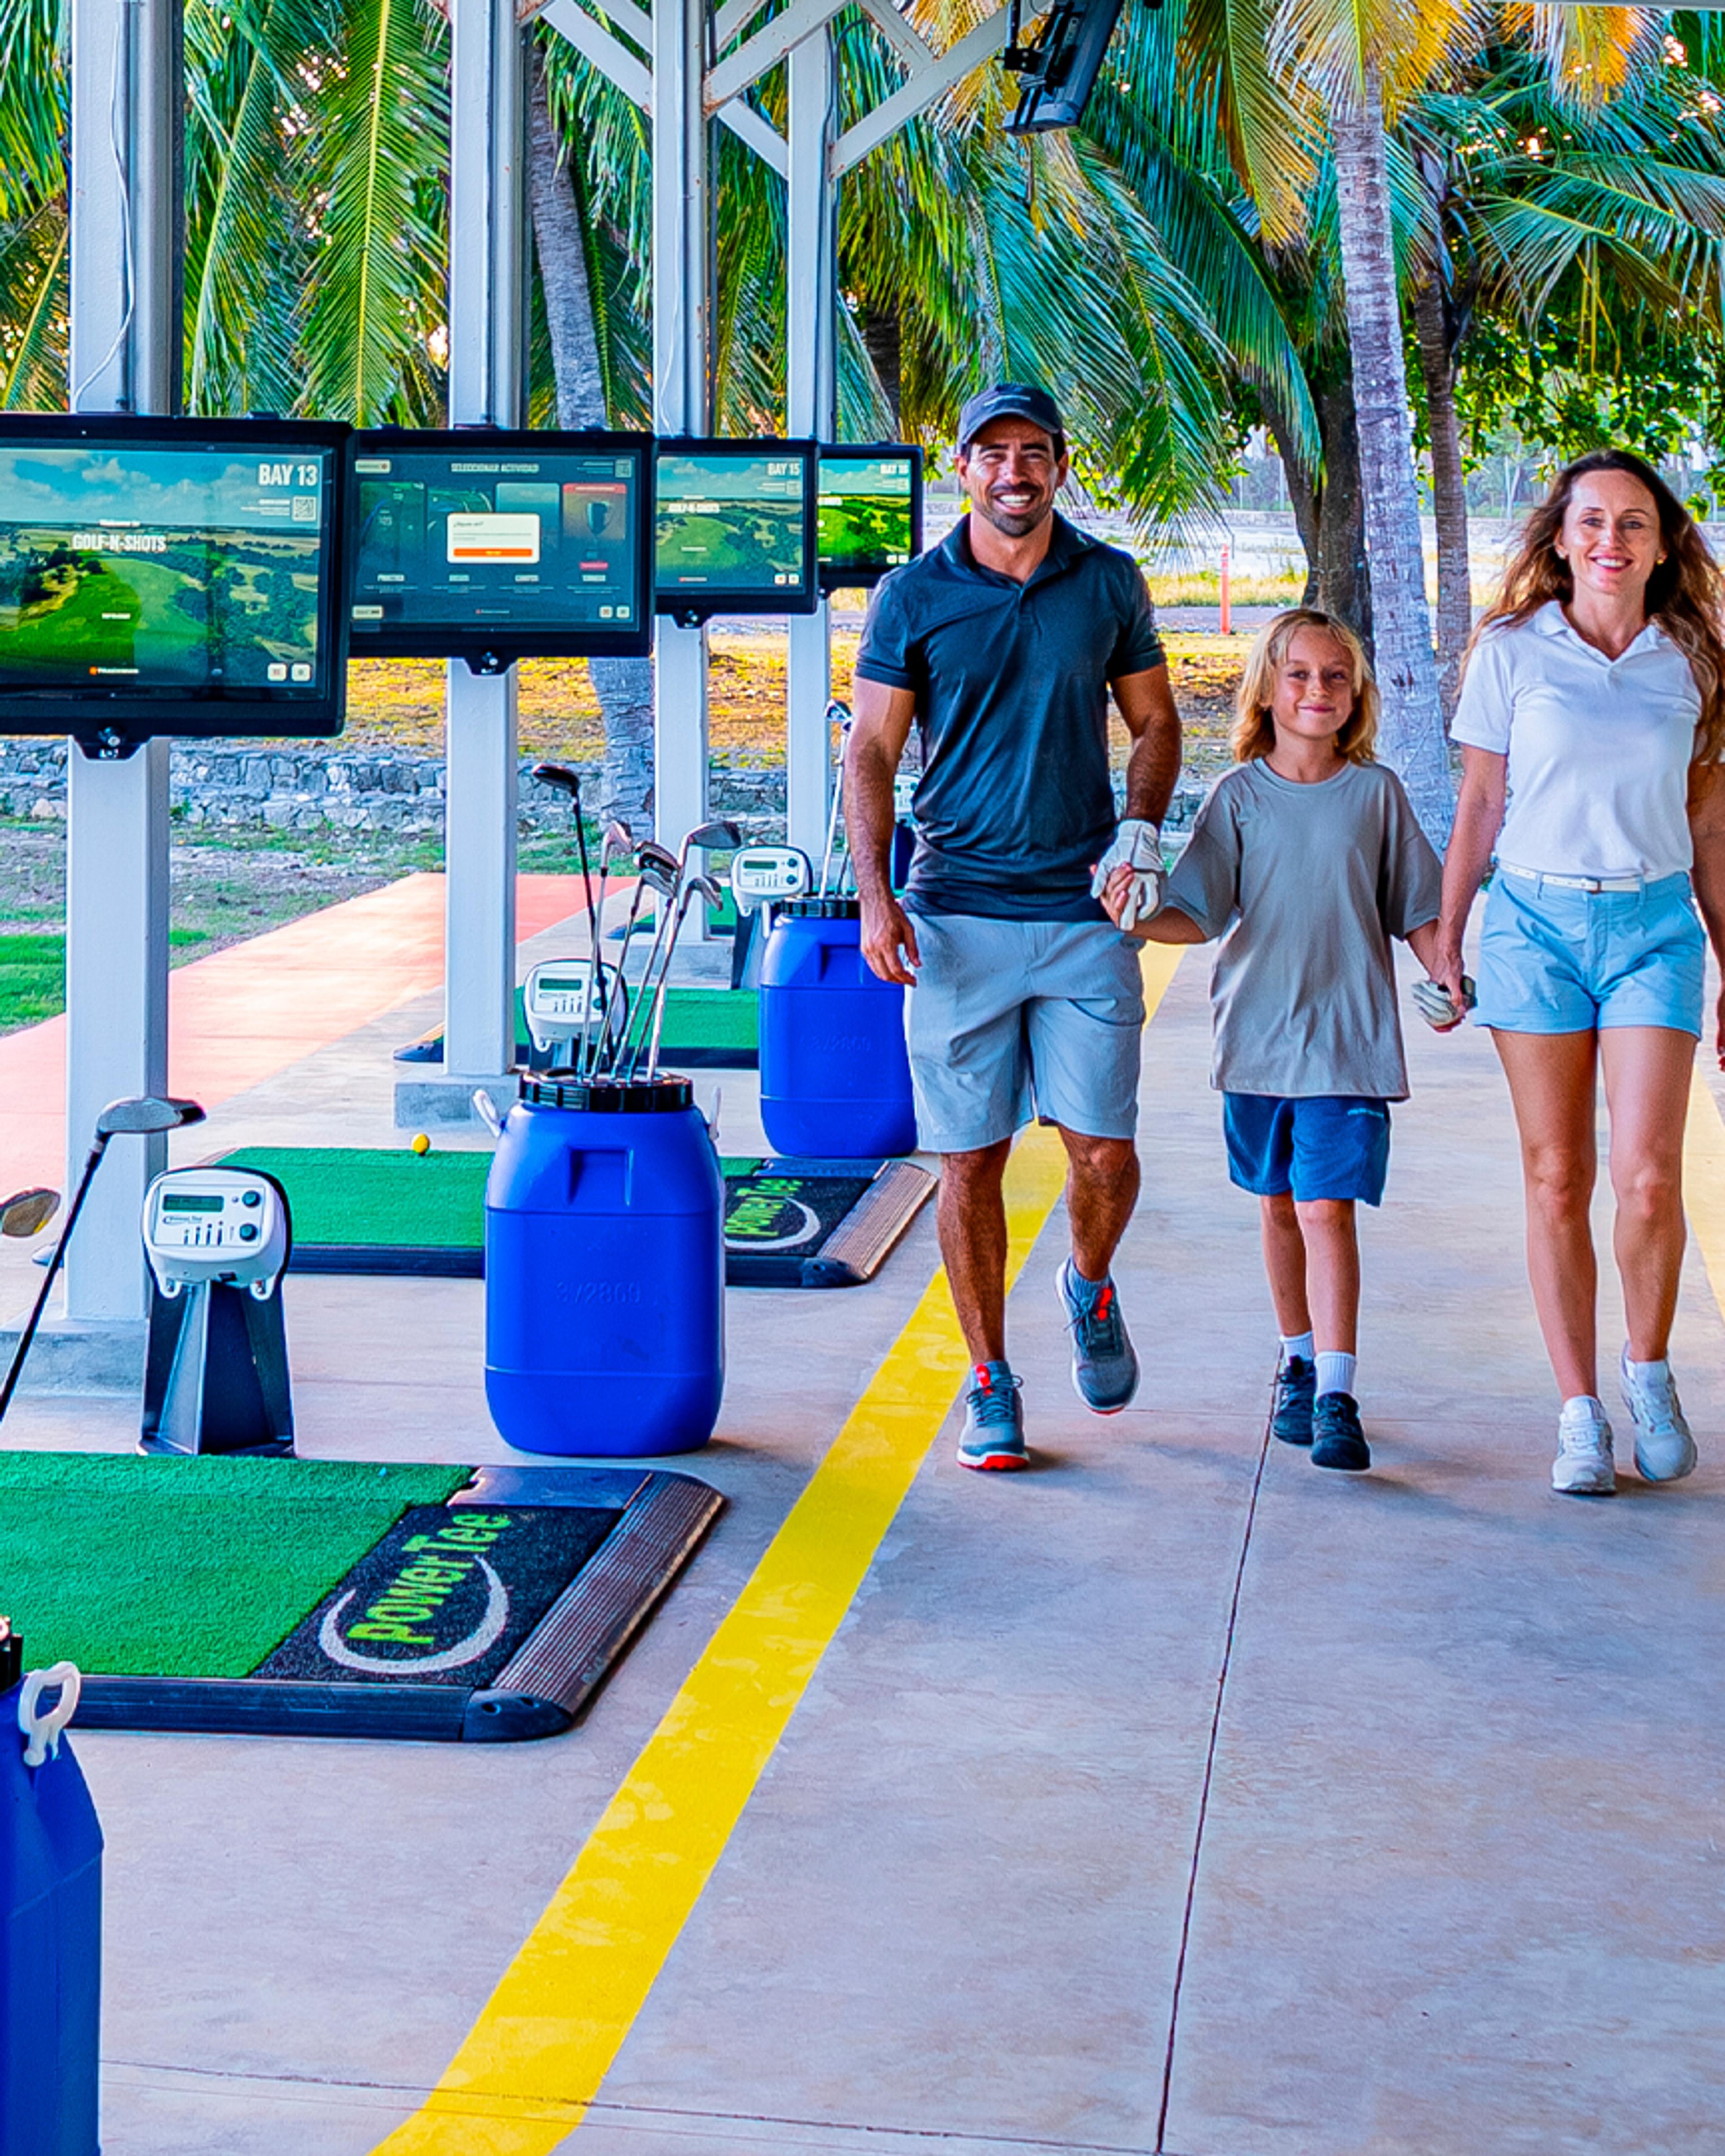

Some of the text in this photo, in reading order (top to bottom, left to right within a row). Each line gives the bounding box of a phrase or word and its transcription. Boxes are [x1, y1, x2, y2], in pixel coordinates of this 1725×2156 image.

[259, 463, 318, 486] BAY 13
[769, 463, 800, 476] BAY 15
[72, 533, 167, 552] GOLF-N-SHOTS
